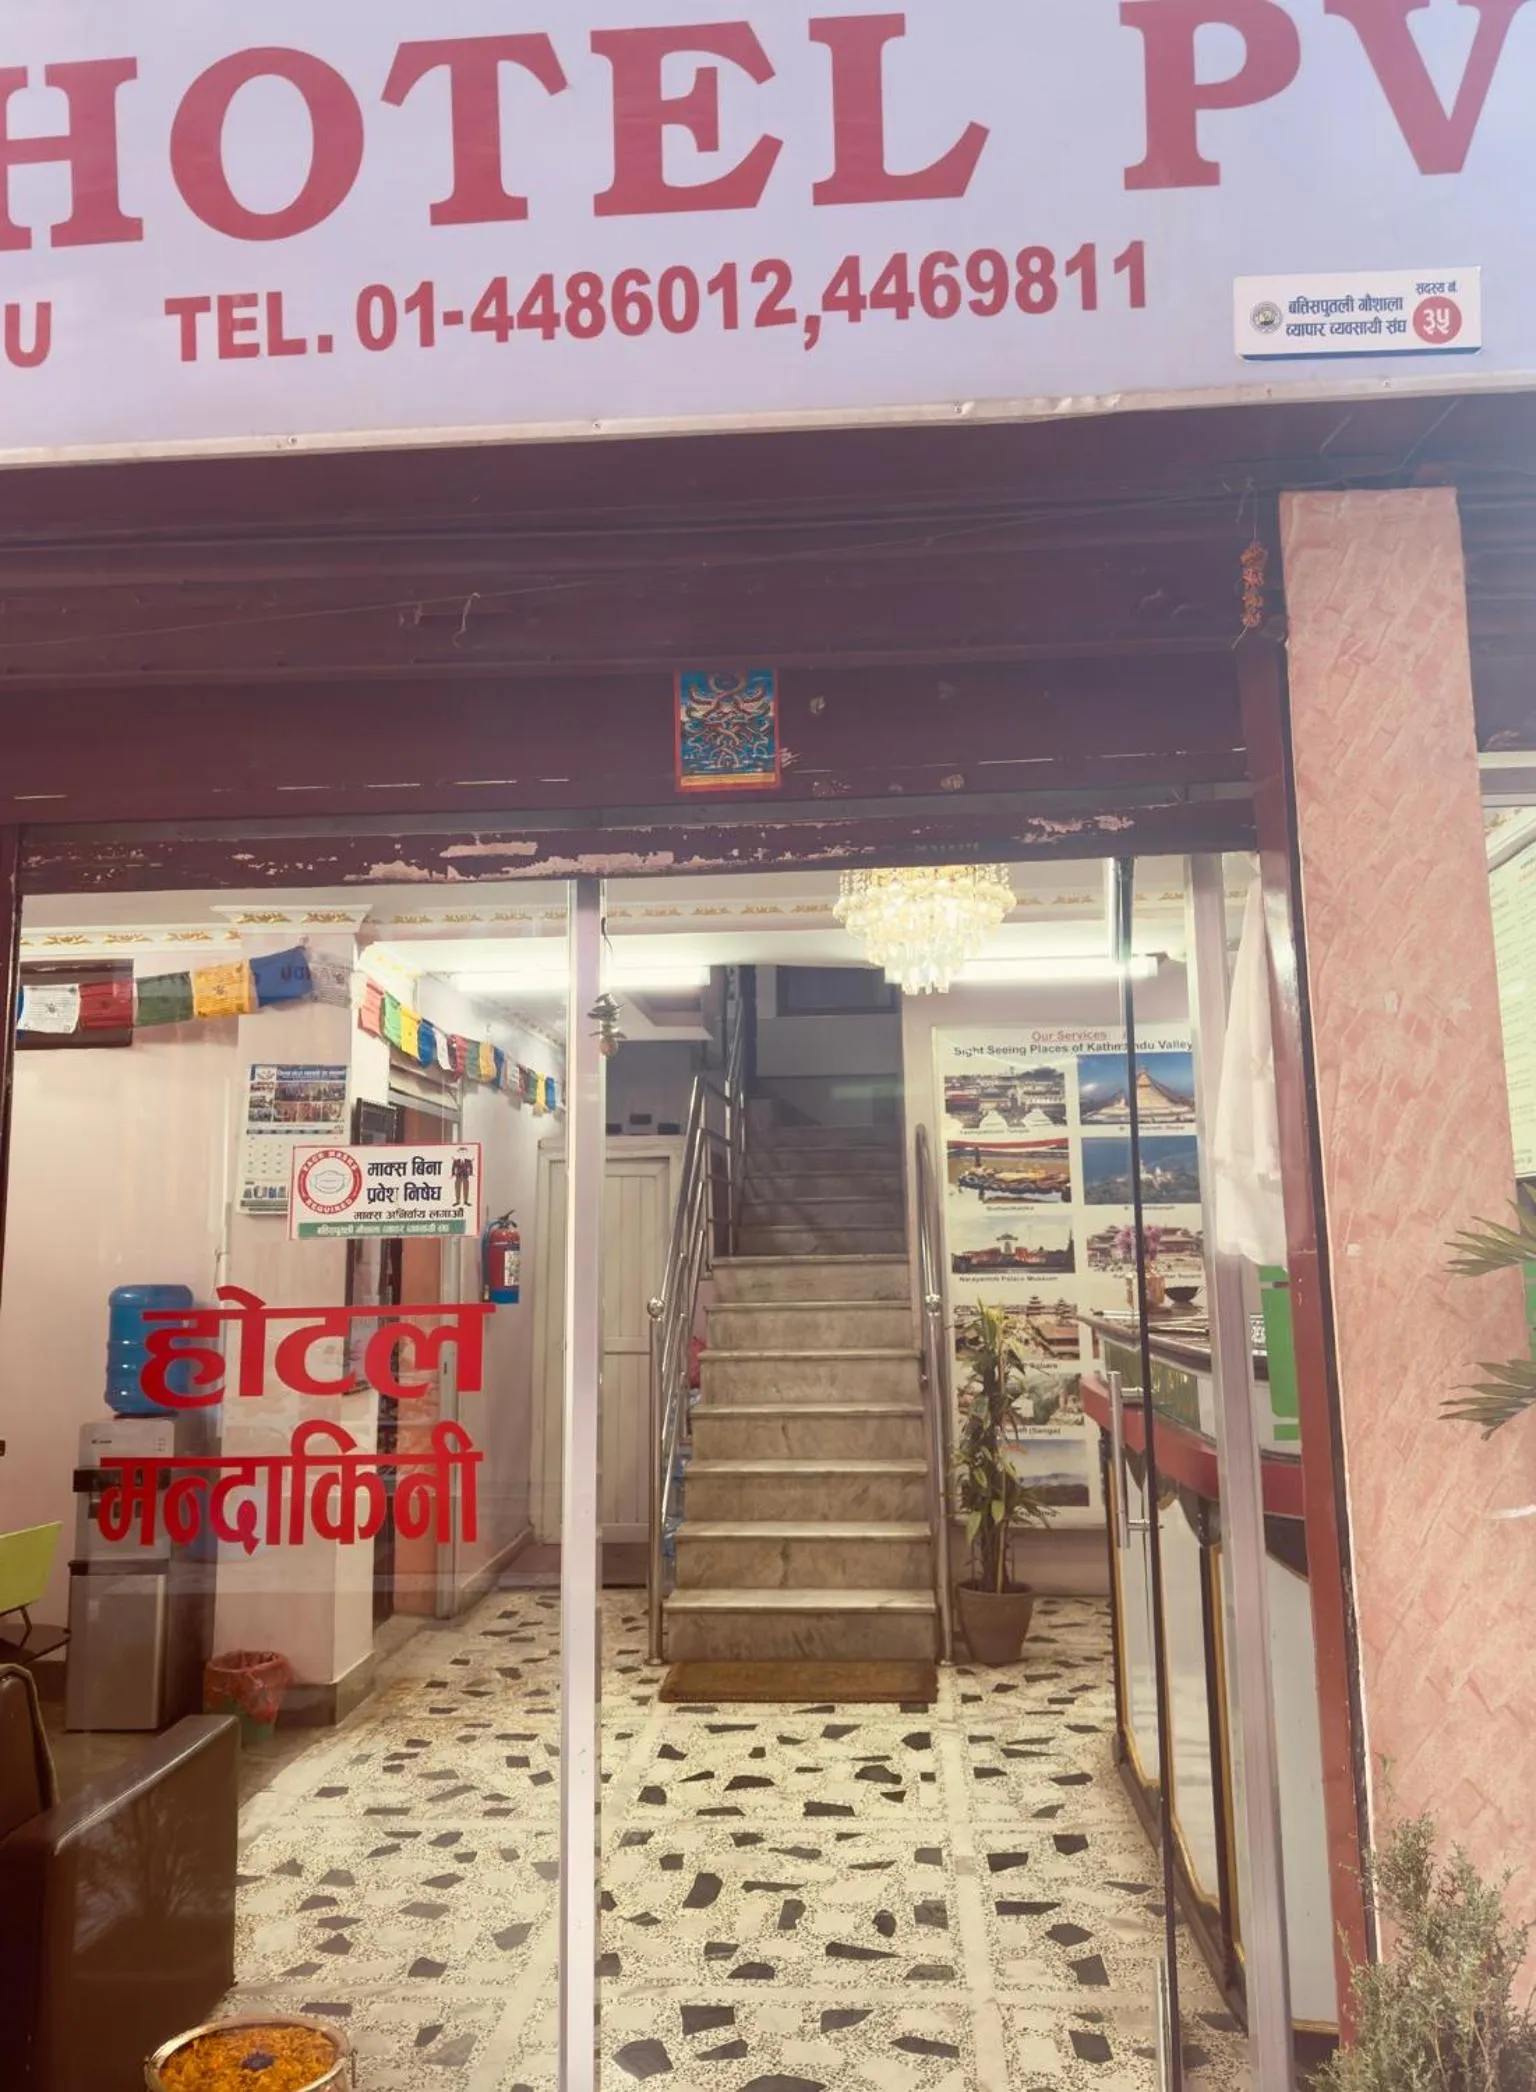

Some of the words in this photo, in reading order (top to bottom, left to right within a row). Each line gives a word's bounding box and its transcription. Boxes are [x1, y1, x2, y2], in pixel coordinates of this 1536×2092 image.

[0, 14, 990, 251] HOTEL
[4, 301, 52, 367] U
[165, 291, 334, 362] TEL.
[355, 240, 1147, 351] 01-4486012,4469811
[954, 1045, 985, 1058] Sight
[987, 1043, 1027, 1057] Seeing
[1030, 1042, 1068, 1054] Places
[1071, 1041, 1084, 1053] of
[1158, 1037, 1192, 1051] Valley
[1032, 1030, 1053, 1042] Our
[1057, 1029, 1108, 1042] Services
[412, 1156, 442, 1176] बिना
[140, 1285, 497, 1409] होटल
[97, 1419, 484, 1556] मन्दाकिनी
